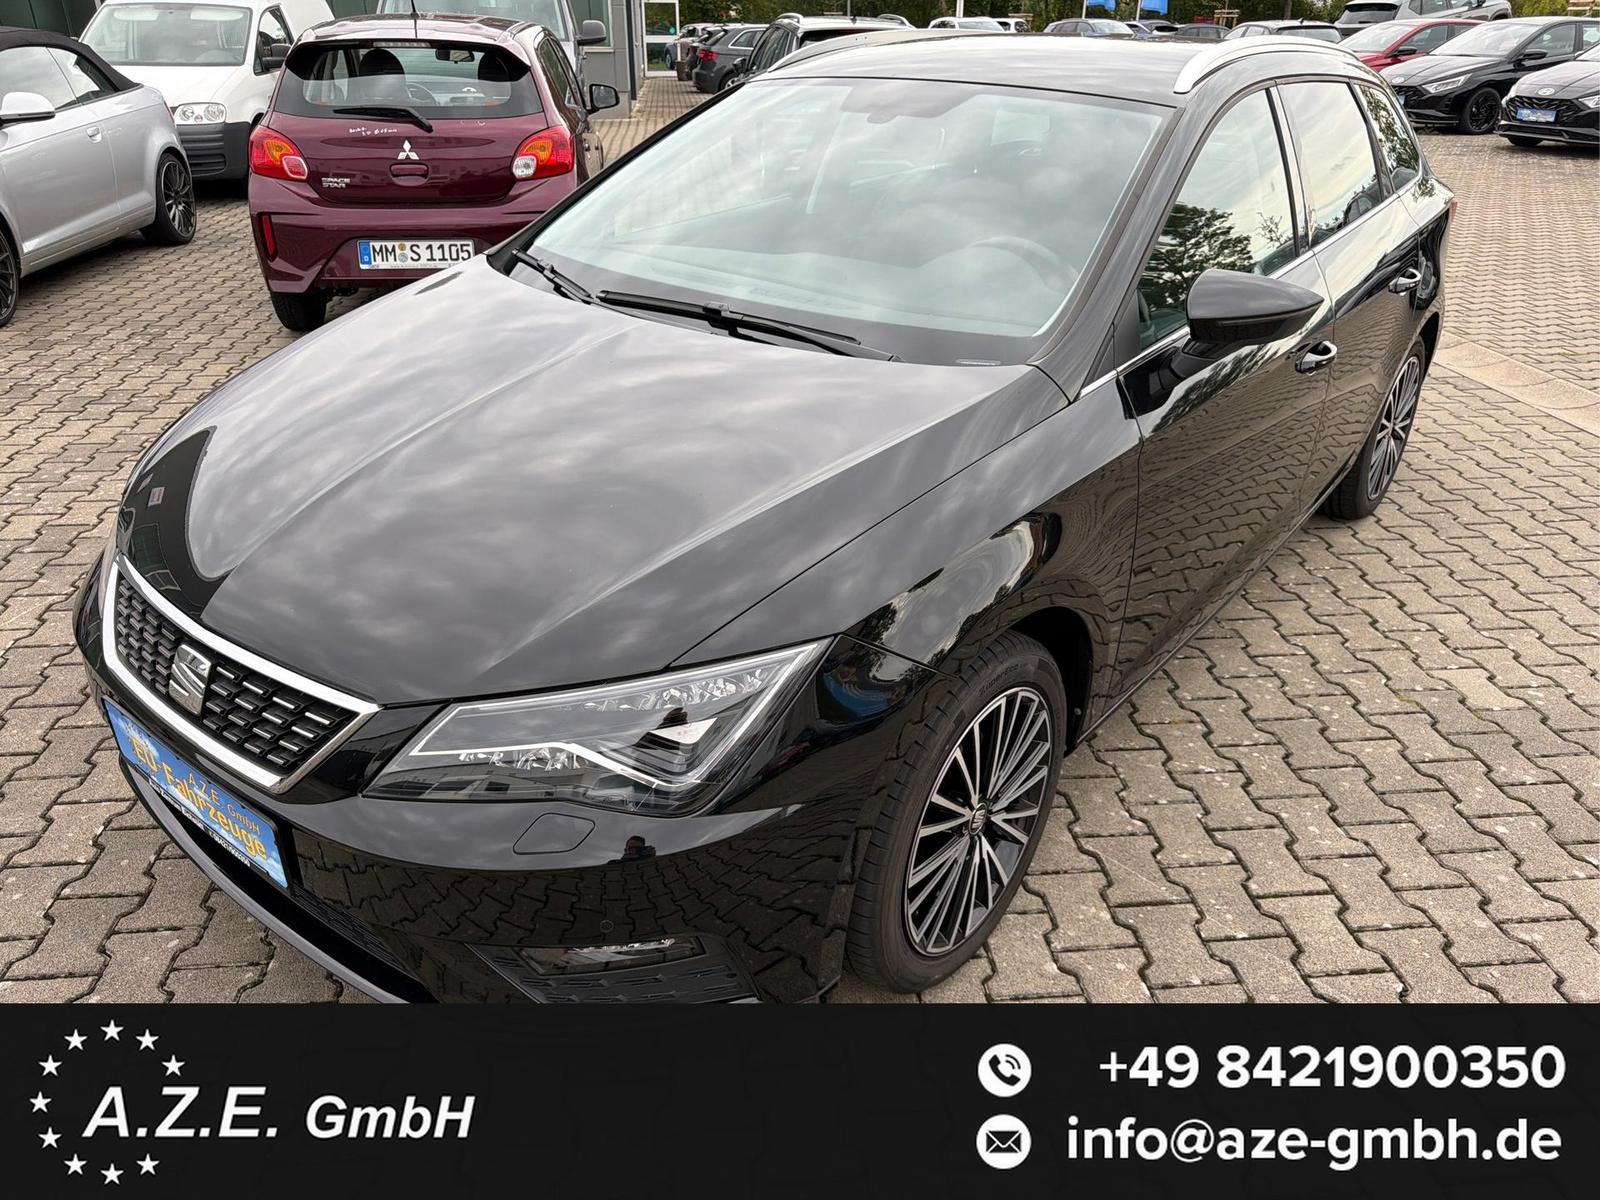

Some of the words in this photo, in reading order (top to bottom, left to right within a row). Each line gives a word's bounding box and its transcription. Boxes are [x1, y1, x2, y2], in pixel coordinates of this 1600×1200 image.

[371, 244, 398, 262] MM
[409, 243, 422, 262] S
[425, 243, 472, 262] 1105
[131, 735, 268, 861] EU-Fahrzeuge
[227, 803, 261, 836] GmbH
